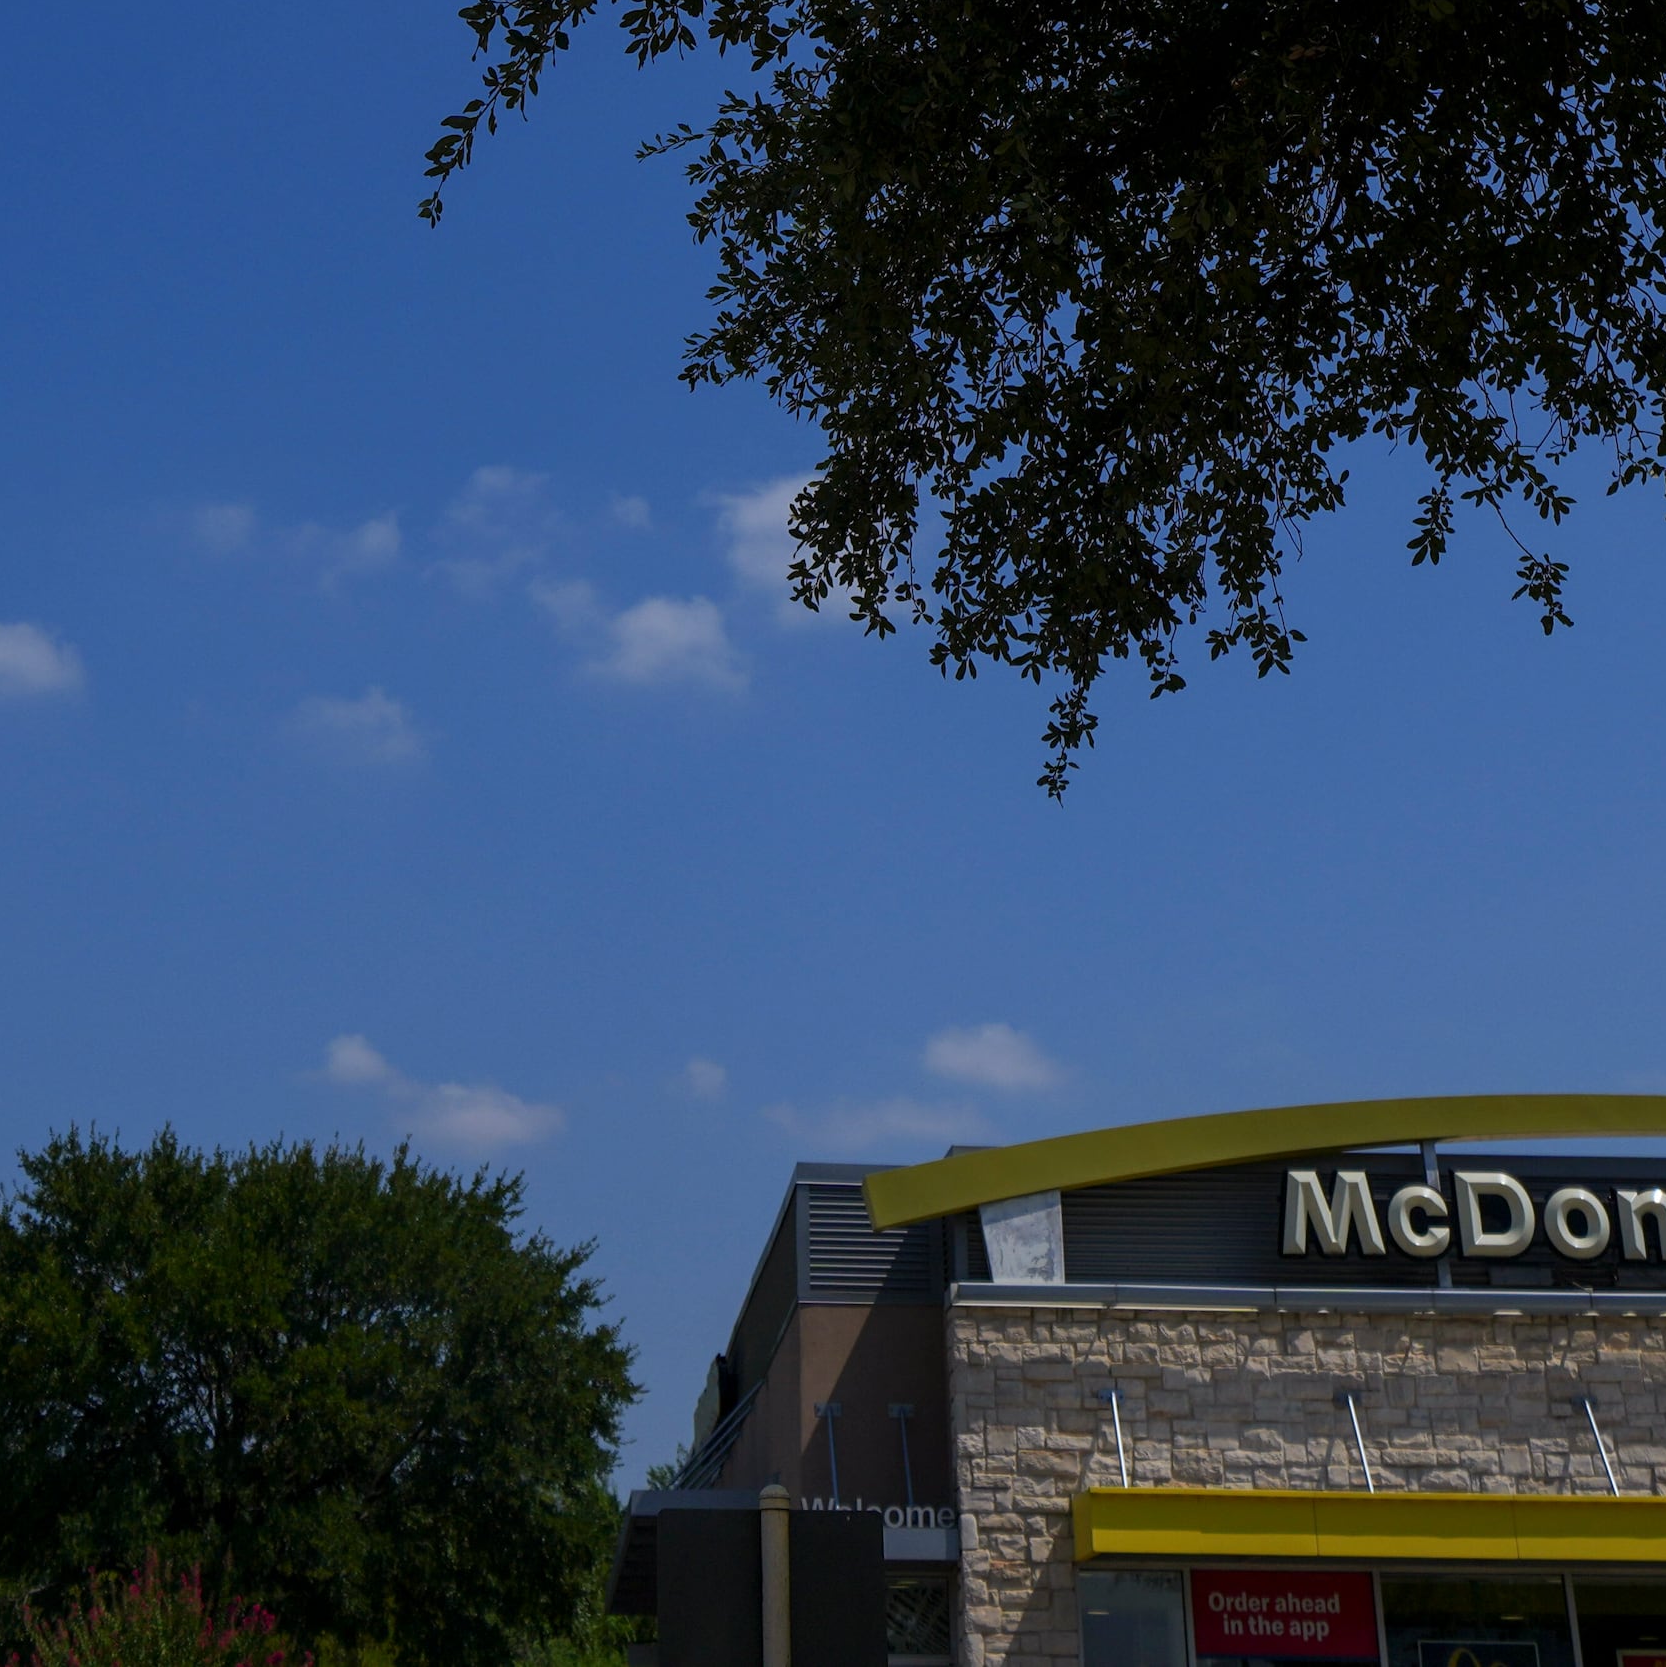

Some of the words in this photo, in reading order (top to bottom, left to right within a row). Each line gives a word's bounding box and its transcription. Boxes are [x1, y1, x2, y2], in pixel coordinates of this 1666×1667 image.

[1208, 1591, 1270, 1613] Order
[1274, 1592, 1341, 1614] ahead
[1222, 1613, 1244, 1636] in
[1247, 1613, 1284, 1636] the
[1288, 1619, 1331, 1643] app
